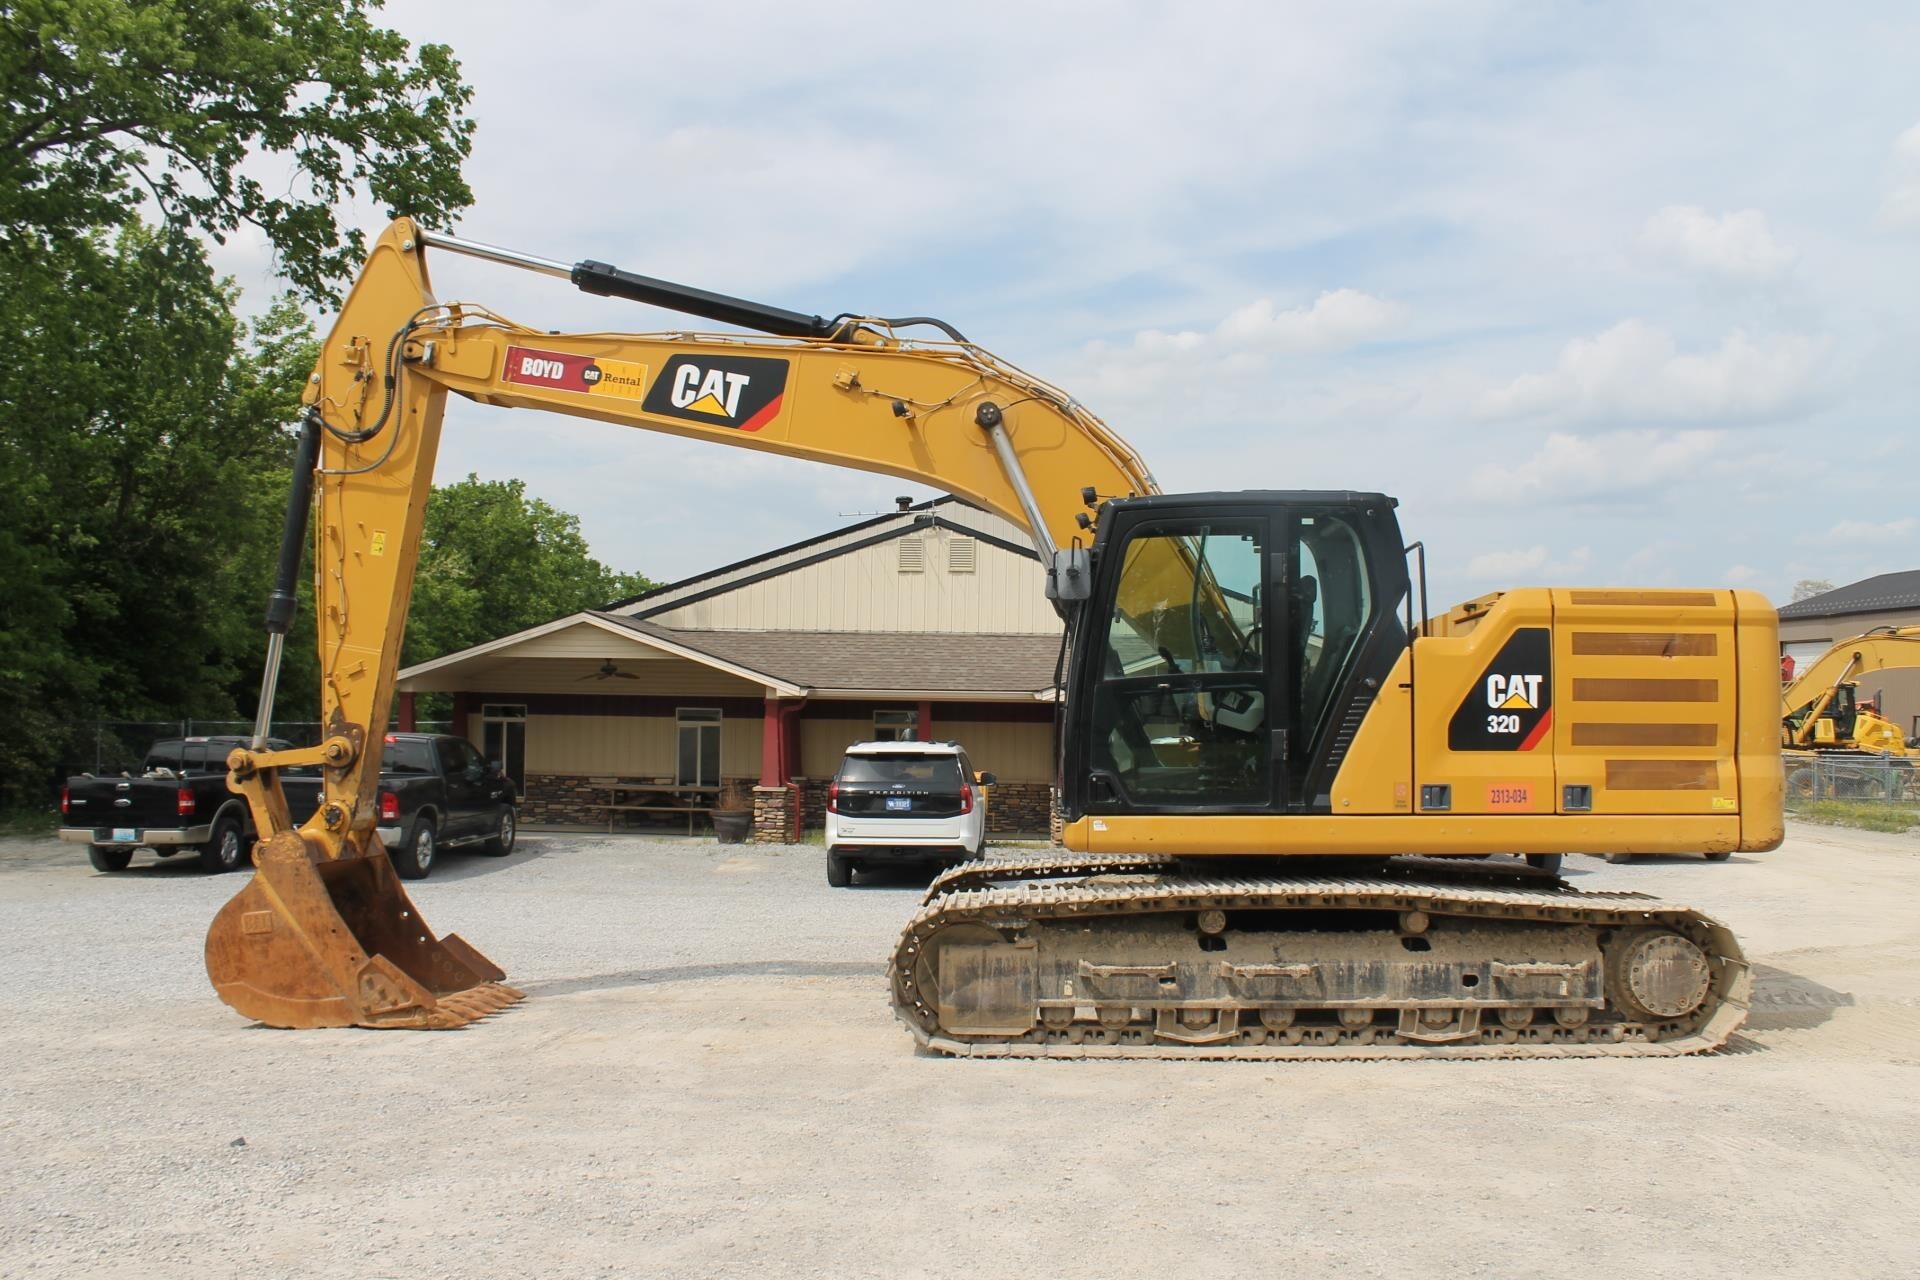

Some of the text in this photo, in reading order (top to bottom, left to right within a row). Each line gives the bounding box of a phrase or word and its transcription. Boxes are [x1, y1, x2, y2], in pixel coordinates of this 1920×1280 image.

[521, 357, 564, 379] BOYD
[584, 370, 641, 386] CAT Rental
[671, 364, 750, 418] CAT
[1487, 674, 1542, 709] CAT
[1487, 715, 1520, 733] 320
[1491, 789, 1527, 803] 2313-034
